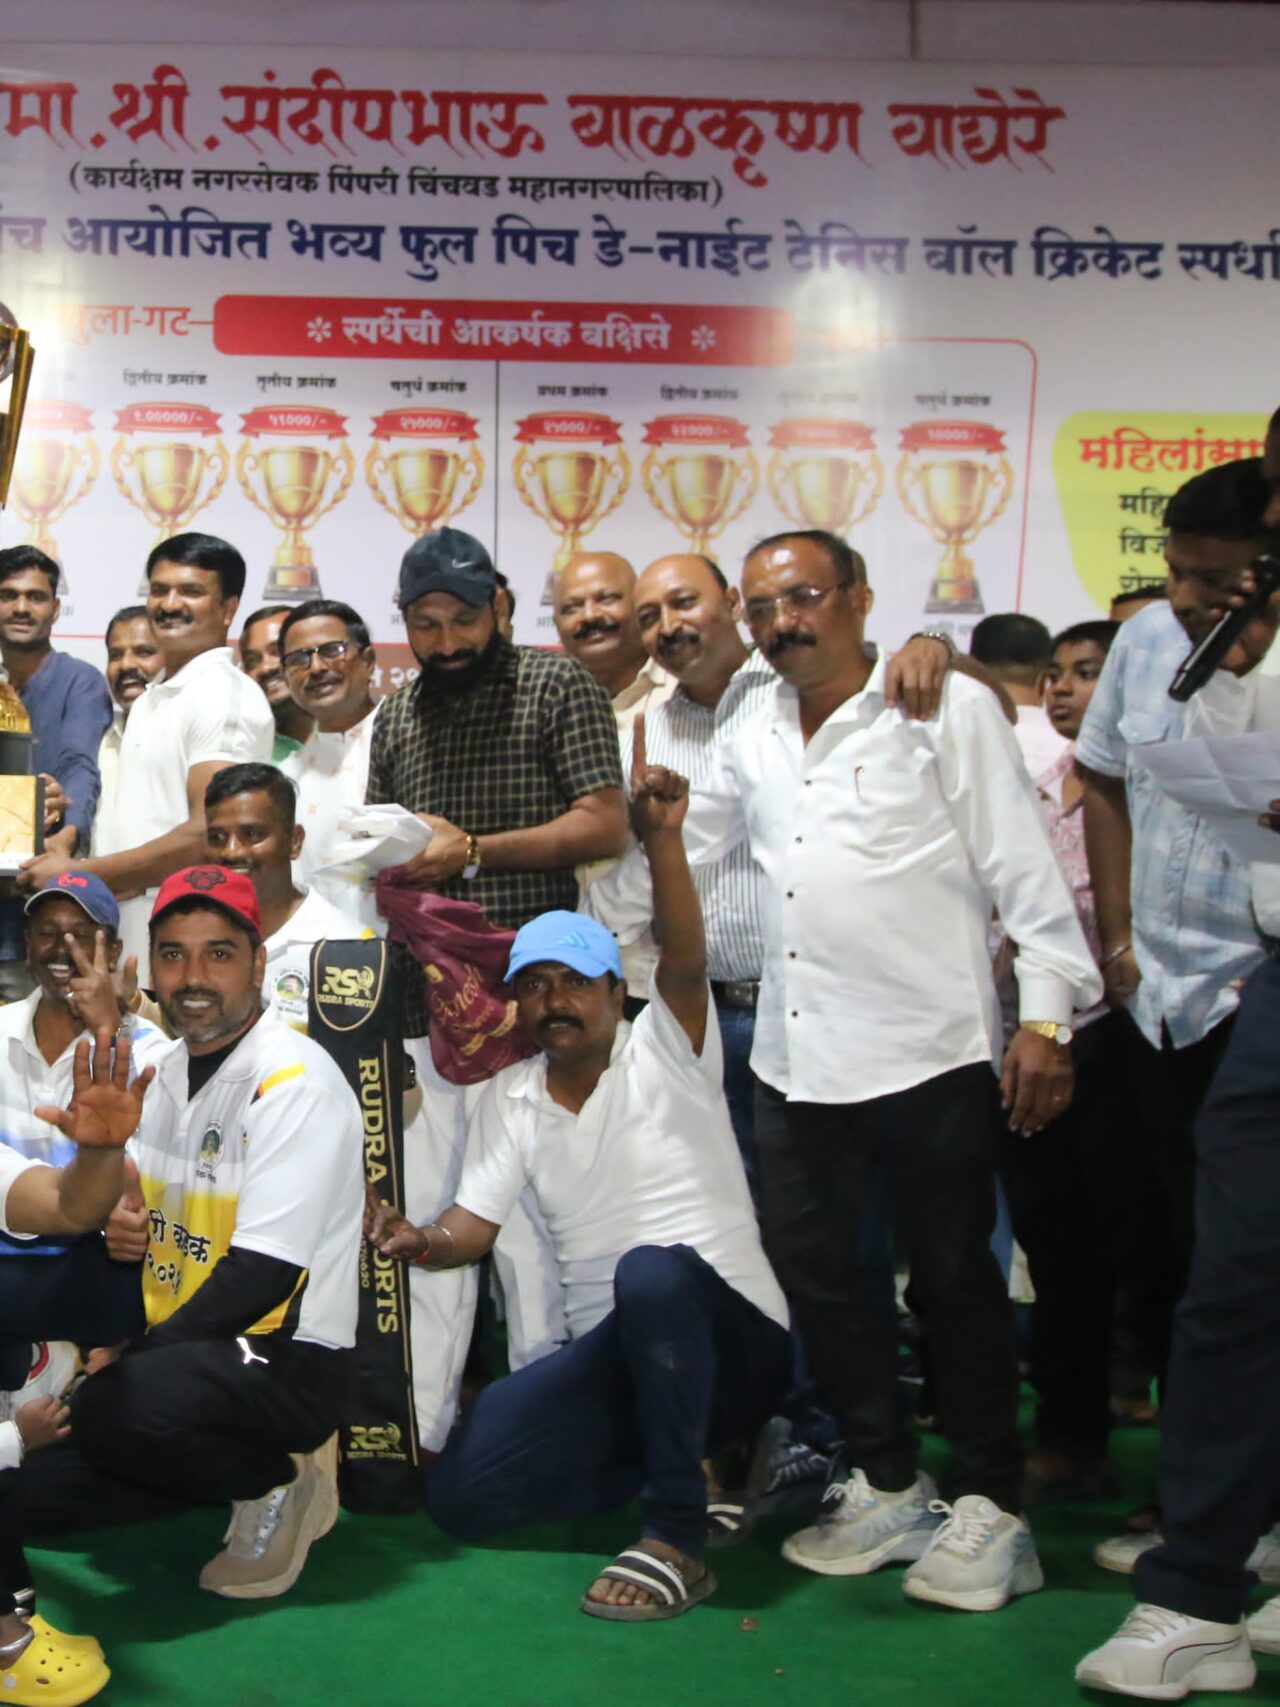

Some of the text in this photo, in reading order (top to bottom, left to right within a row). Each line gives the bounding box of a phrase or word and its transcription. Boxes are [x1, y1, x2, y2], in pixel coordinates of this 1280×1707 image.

[566, 92, 873, 188] बाळकृष्ण
[888, 86, 1067, 172] वाघेरे
[192, 161, 318, 194] नगरसेवक
[328, 161, 398, 197] पिंपरी
[408, 164, 499, 199] चिंचवड
[62, 205, 271, 262] आयोजित
[288, 219, 385, 262] भव्य
[400, 220, 479, 282] फुल
[492, 215, 580, 267] पिच
[785, 219, 909, 275] टेनिस
[924, 225, 1017, 276] बॉल
[1030, 225, 1163, 281] क्रिकेट
[341, 307, 442, 346] स्पर्धेची
[451, 310, 572, 347] आकर्षक
[1078, 426, 1266, 473] महिलांसा
[358, 1056, 388, 1185] RUDRA
